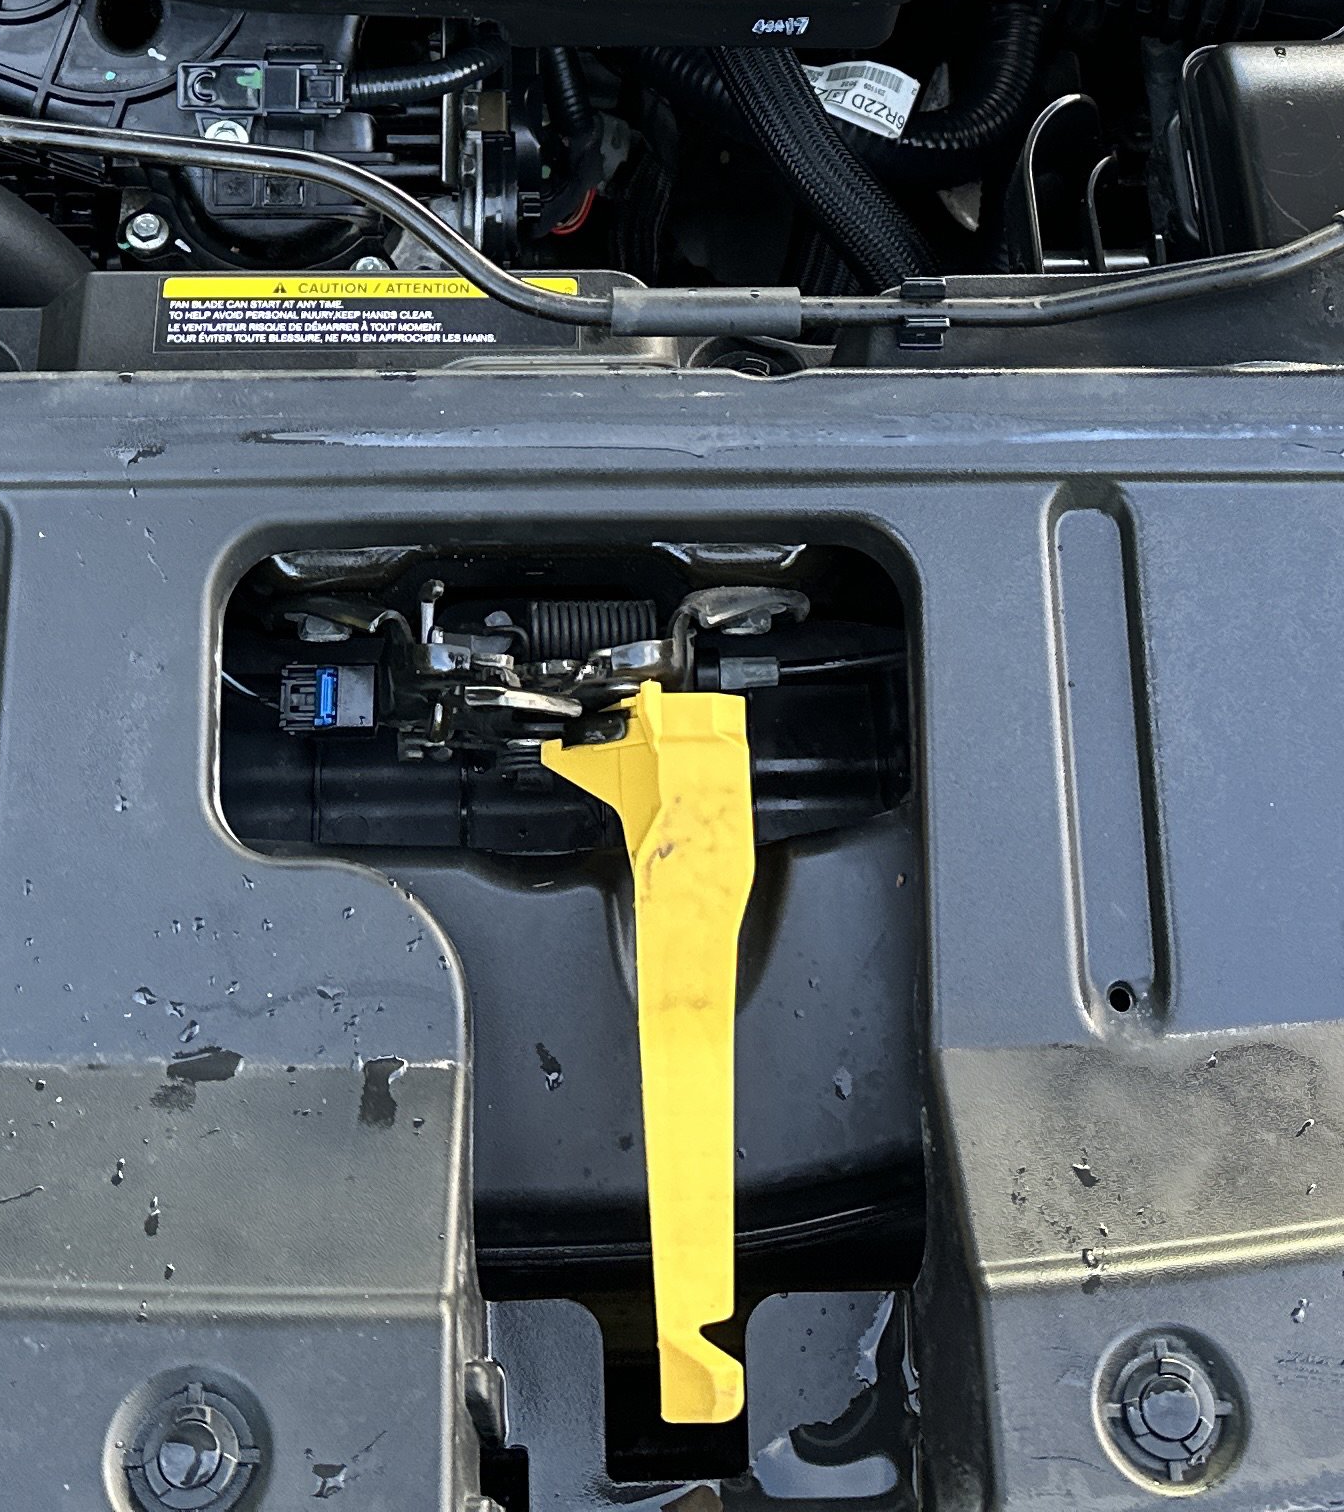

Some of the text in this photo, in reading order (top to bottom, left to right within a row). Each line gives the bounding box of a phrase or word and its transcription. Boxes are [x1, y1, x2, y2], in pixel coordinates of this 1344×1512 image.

[851, 93, 906, 130] 6RZ2D
[298, 282, 368, 294] CAUTION
[385, 282, 470, 294] ATTENTION
[169, 300, 189, 309] FAN
[191, 300, 224, 309] BLADE
[226, 300, 248, 309] CAN
[250, 300, 281, 309] START
[282, 300, 296, 309] AT
[296, 300, 317, 309] ANY
[169, 311, 183, 320] TO
[185, 311, 211, 320] HELP
[212, 311, 243, 320] AVOID
[245, 311, 299, 320] PERSONAL
[362, 311, 397, 320] HANDS
[400, 311, 434, 320] CLEAR.
[168, 322, 181, 332] LE
[182, 322, 247, 332] VENTILATEUR
[249, 322, 286, 332] RISQUE
[288, 322, 302, 332] DE
[304, 320, 359, 332] DÉMARRER
[369, 322, 396, 332] TOUT
[167, 334, 197, 343] POUR
[198, 332, 232, 343] ÉVITER
[234, 334, 266, 343] TOUTE
[325, 334, 339, 343] NE
[341, 334, 361, 343] PAS
[363, 334, 377, 343] EN
[378, 334, 440, 343] APPROCHER
[442, 334, 461, 343] LES
[463, 334, 496, 343] MAINS.
